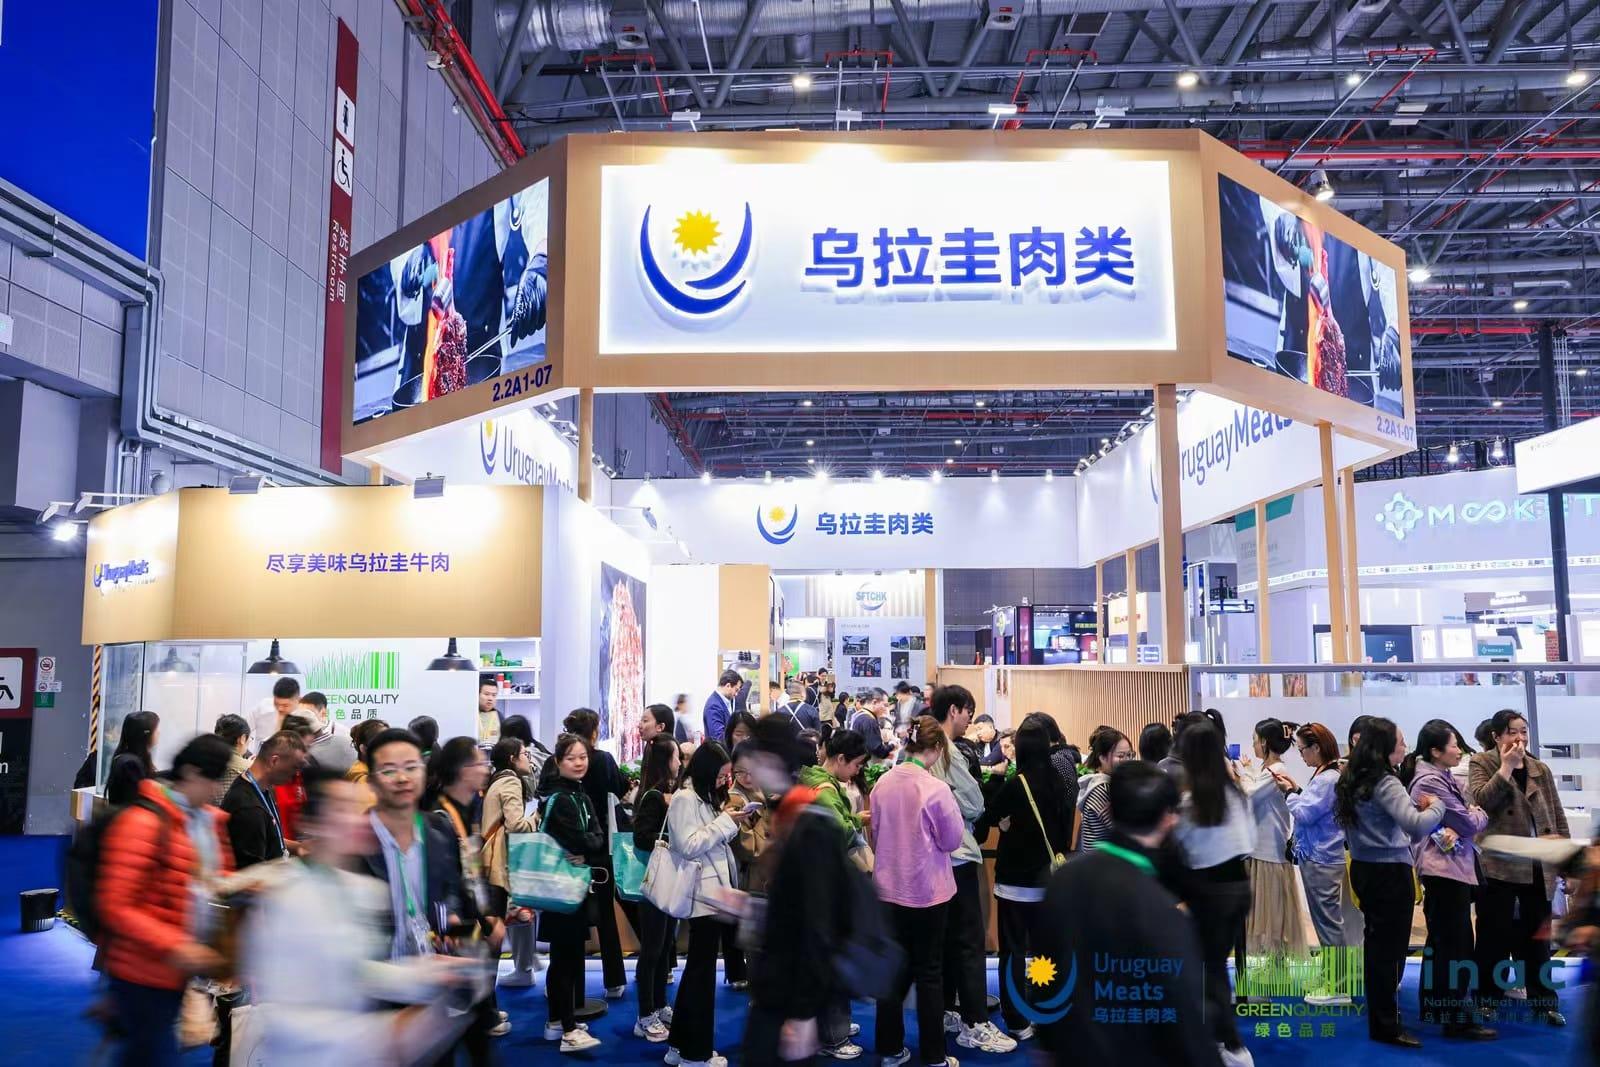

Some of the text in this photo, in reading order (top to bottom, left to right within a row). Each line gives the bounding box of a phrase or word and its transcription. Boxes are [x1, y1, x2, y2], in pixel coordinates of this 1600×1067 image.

[329, 219, 340, 302] Restroom
[337, 226, 350, 304] 洗手间
[805, 226, 1135, 288] 乌拉圭肉类
[492, 364, 553, 402] 2.2A1-07
[1376, 415, 1415, 442] 2.2A1-07
[1181, 405, 1294, 486] ruguayMea
[815, 512, 935, 535] 乌拉圭肉类
[265, 552, 450, 574] 尽享美味乌拉圭牛肉
[855, 591, 887, 601] SFTCHK
[325, 694, 399, 704] ENQUALITY
